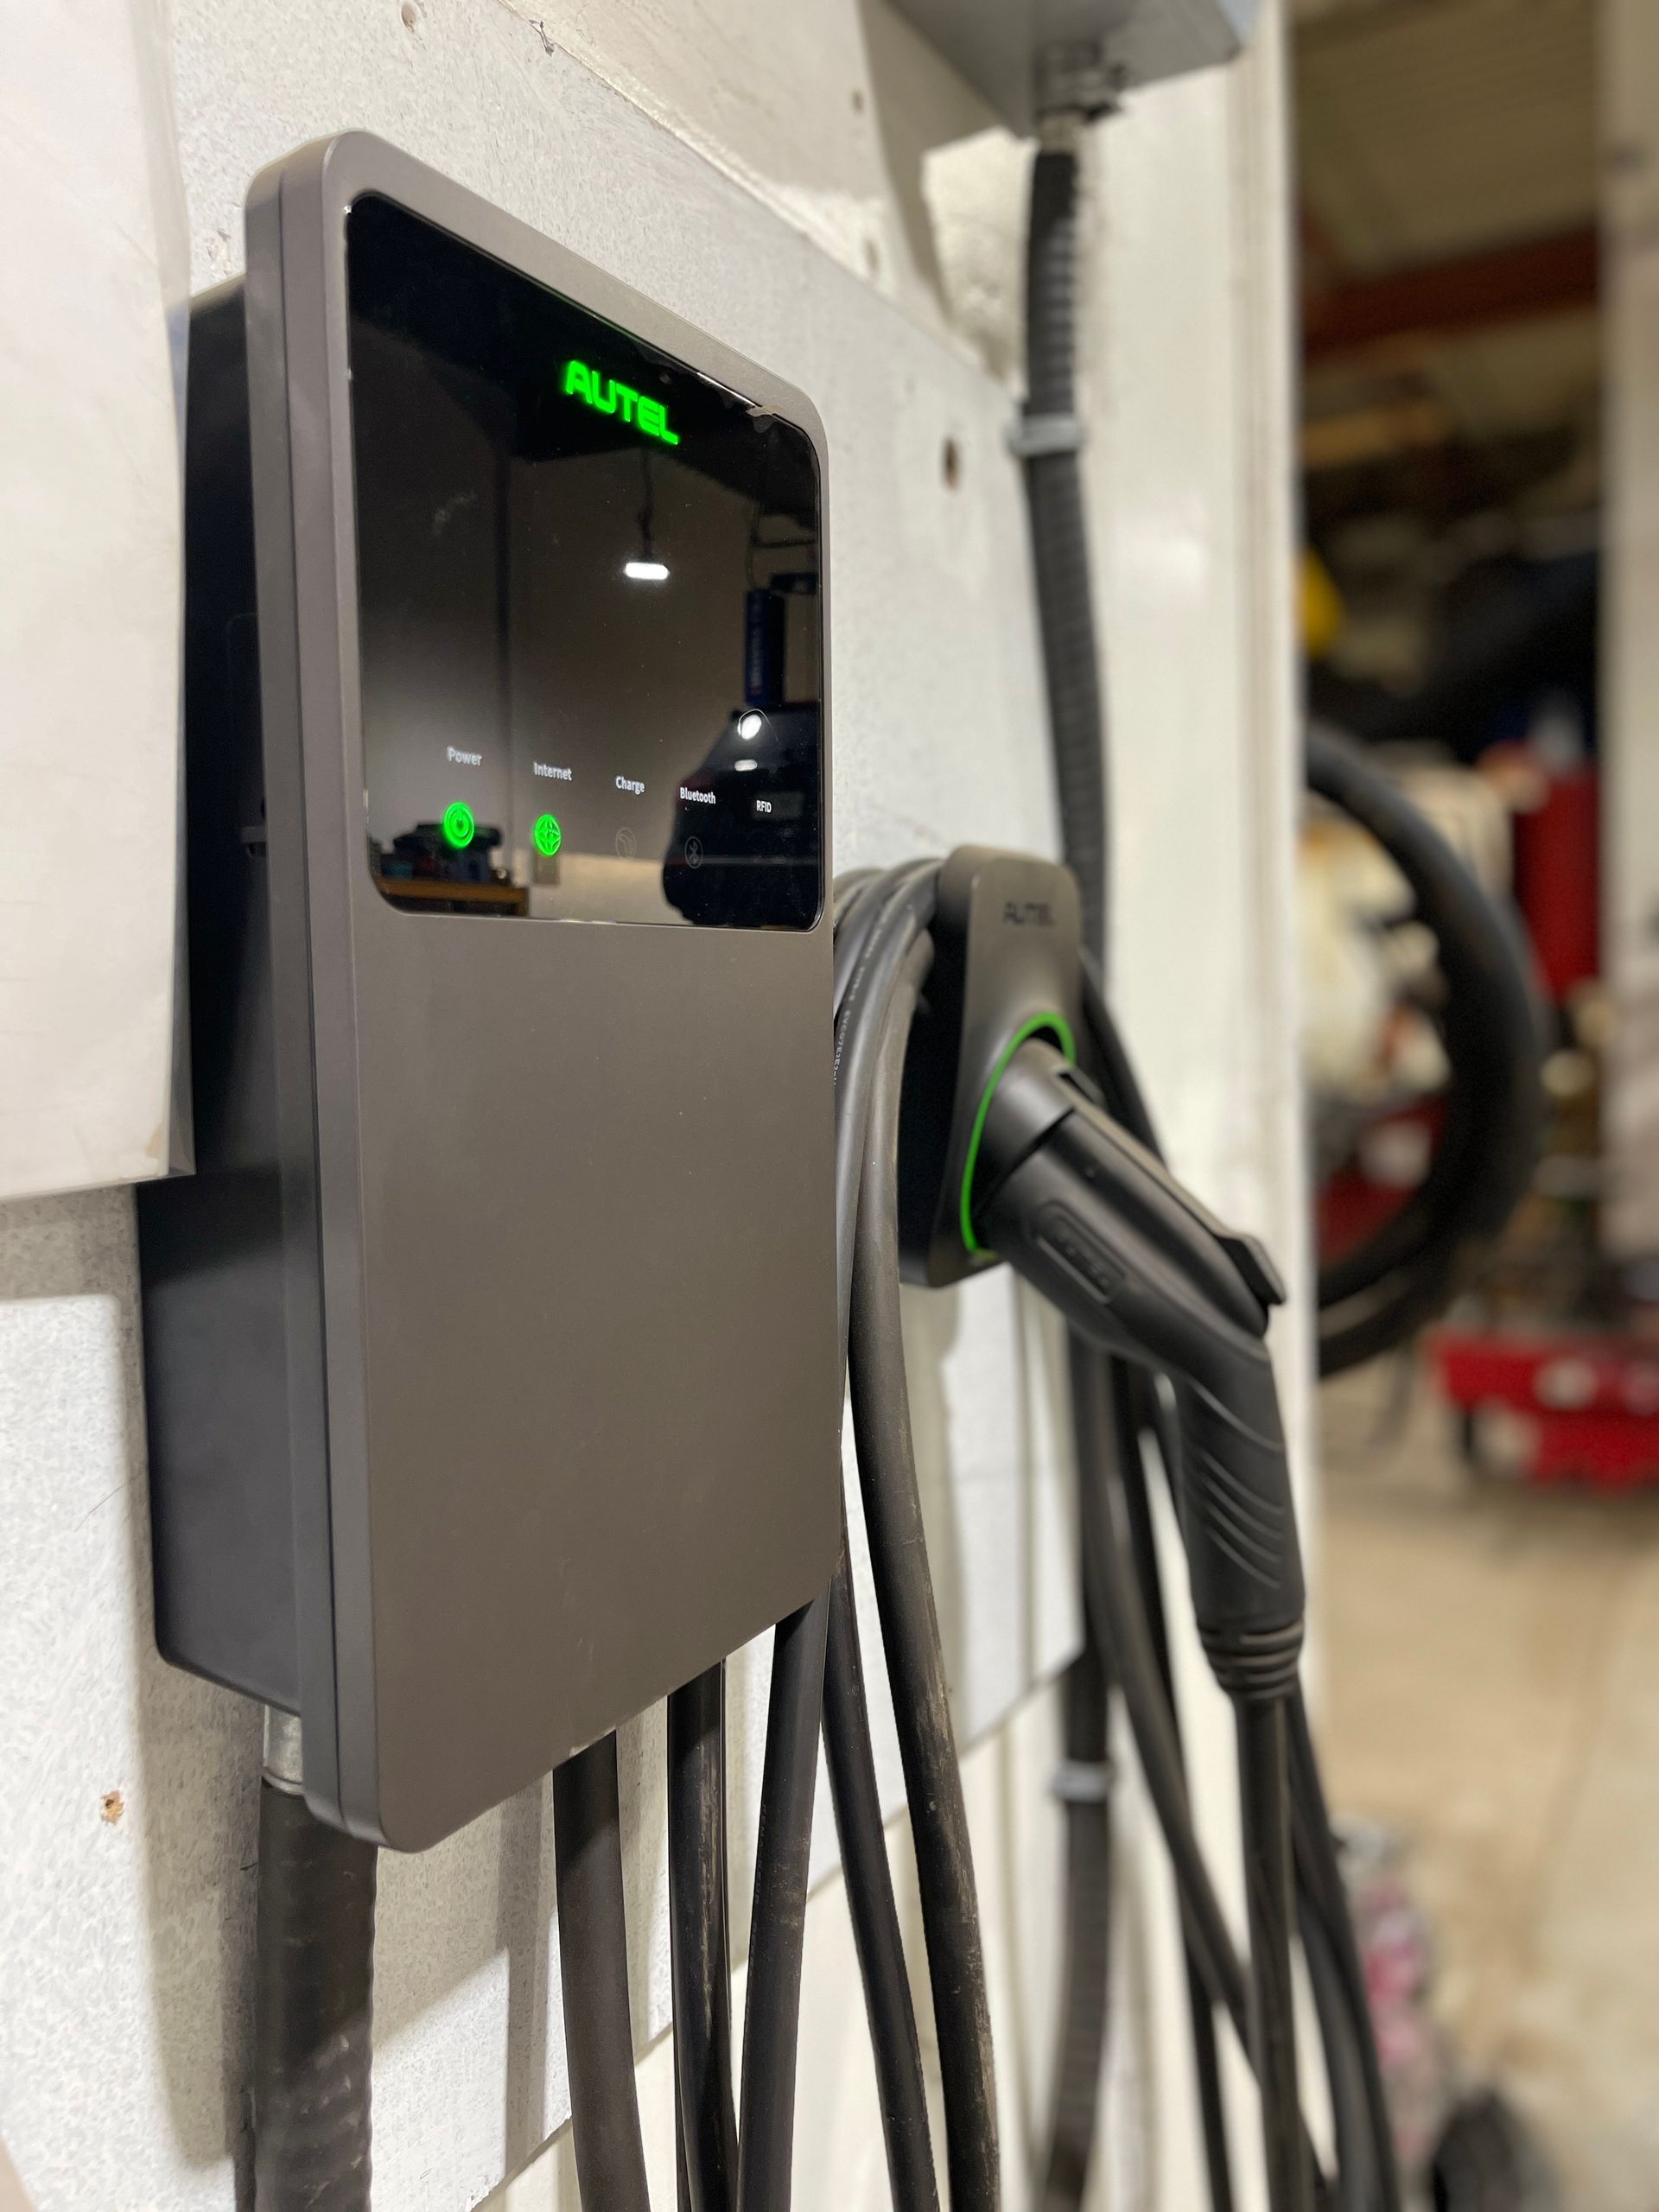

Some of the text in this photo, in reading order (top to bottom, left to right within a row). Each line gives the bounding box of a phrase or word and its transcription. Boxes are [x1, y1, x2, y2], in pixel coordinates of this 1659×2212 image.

[564, 359, 679, 446] AUTEL
[447, 746, 483, 766] Power
[532, 761, 573, 781] Internet
[615, 776, 645, 795] Charge
[679, 787, 716, 804] Bluetooth
[756, 800, 772, 813] RFID
